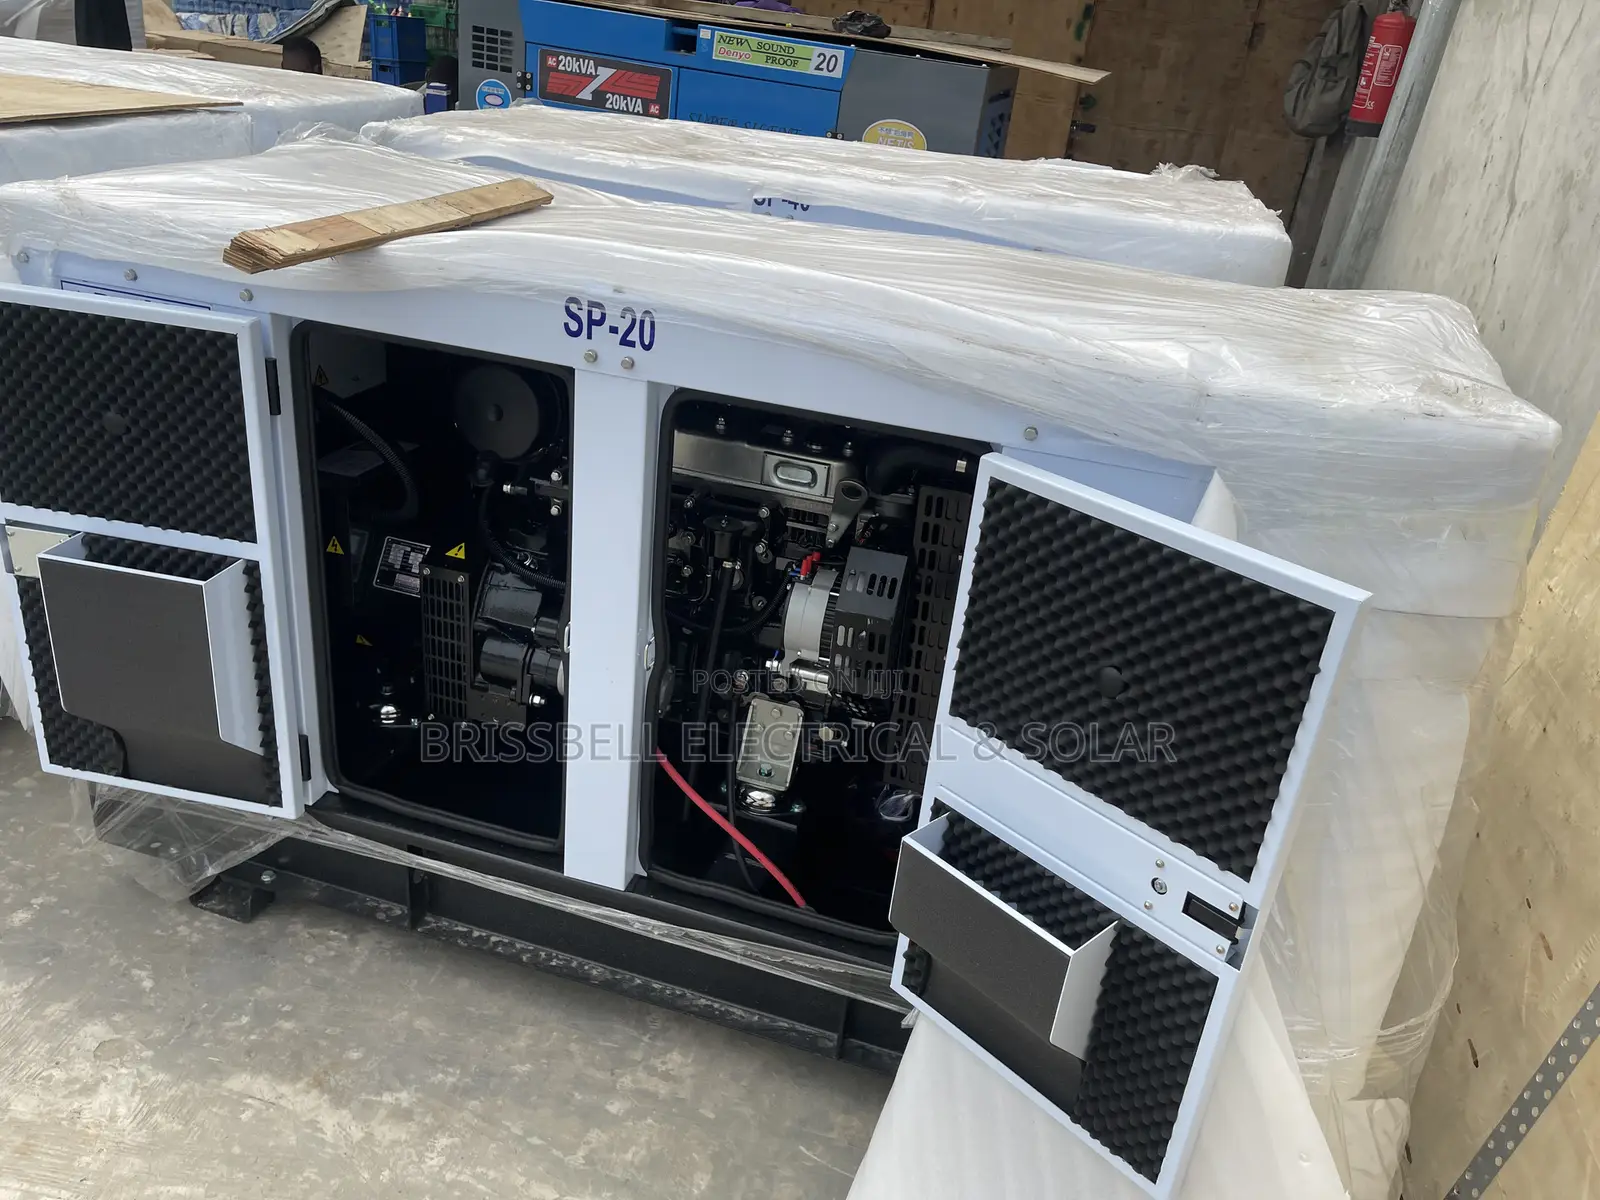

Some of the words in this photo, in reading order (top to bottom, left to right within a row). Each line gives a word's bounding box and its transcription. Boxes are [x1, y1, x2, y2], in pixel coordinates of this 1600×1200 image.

[717, 34, 747, 47] NEW
[756, 41, 795, 55] SOUND
[718, 46, 751, 60] Denyo
[547, 56, 557, 66] AC
[558, 55, 596, 75] 20kVA
[765, 55, 799, 68] PROOF
[814, 52, 839, 73] 20
[605, 93, 643, 114] 20kVA
[650, 105, 660, 114] AC
[563, 296, 655, 351] SP-20
